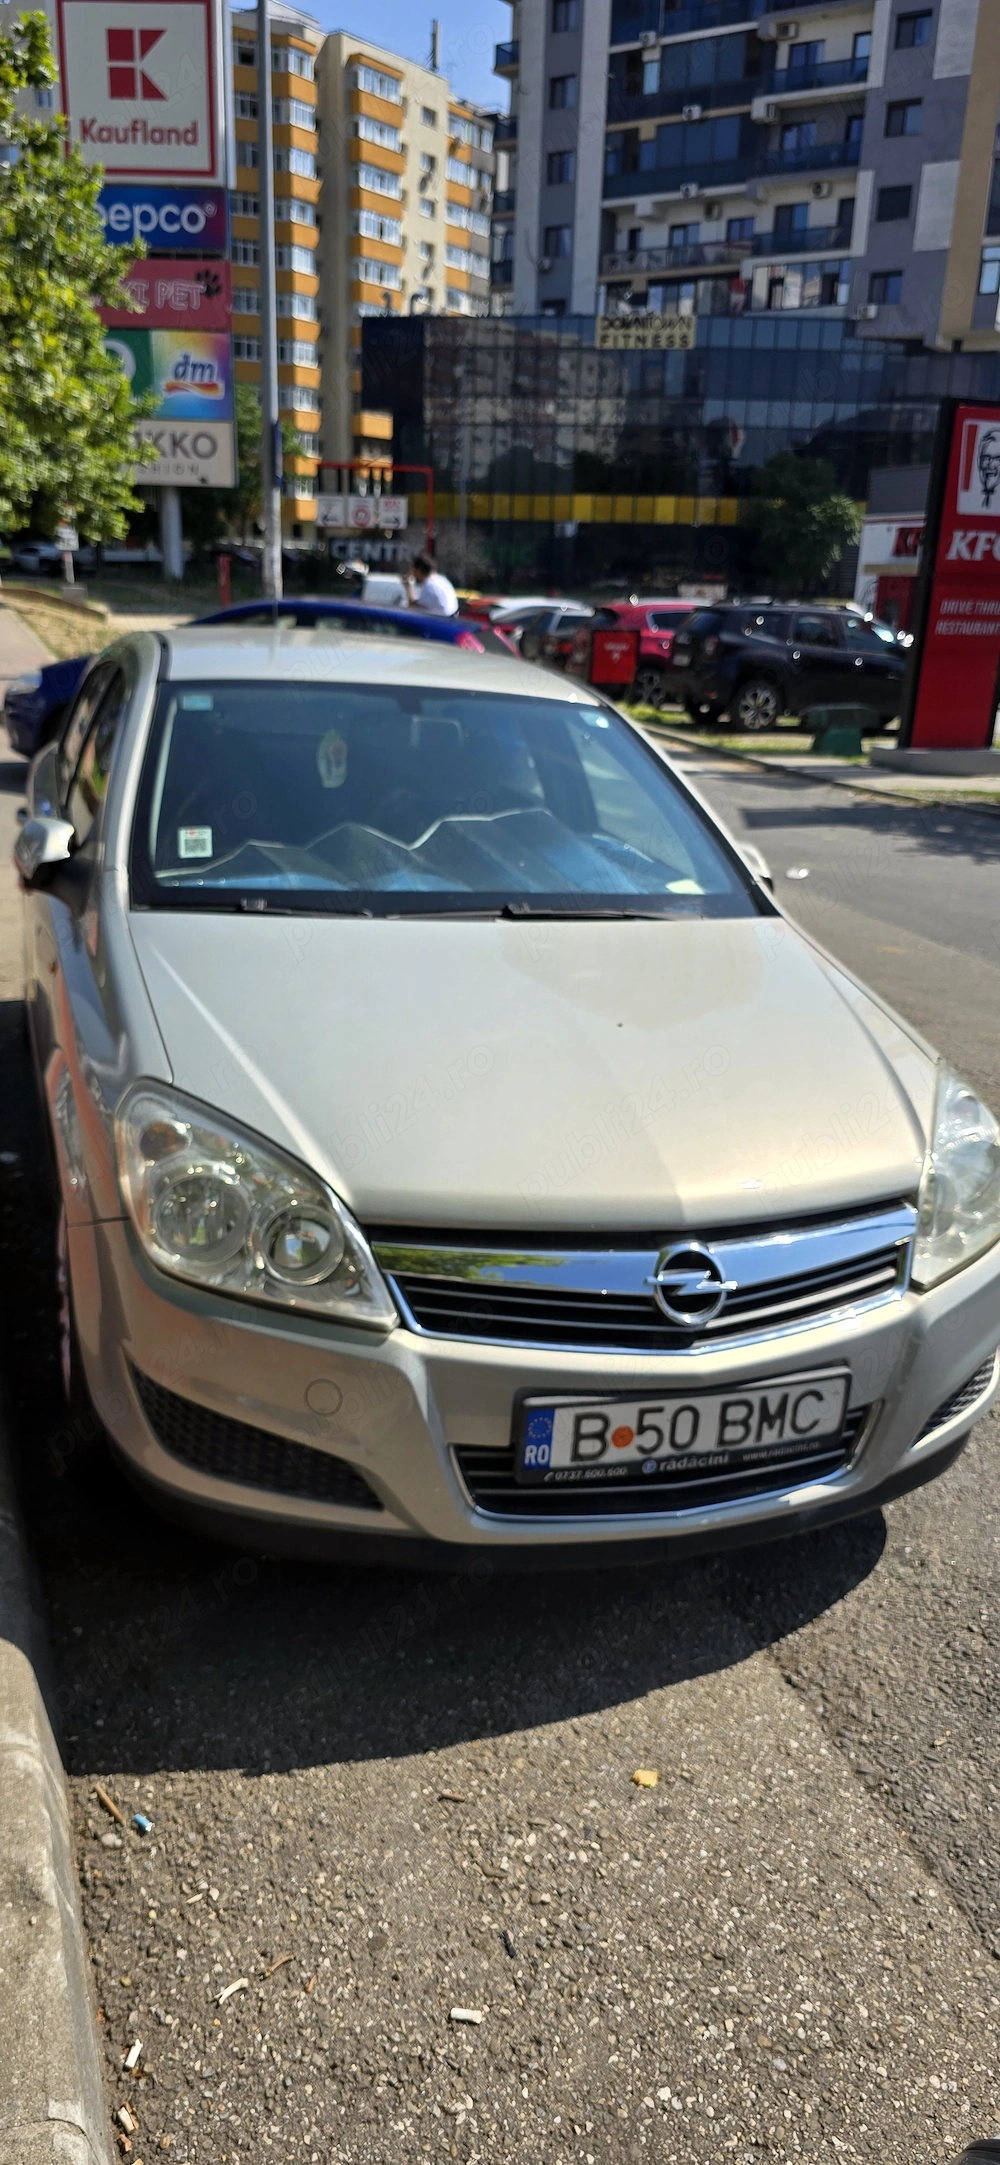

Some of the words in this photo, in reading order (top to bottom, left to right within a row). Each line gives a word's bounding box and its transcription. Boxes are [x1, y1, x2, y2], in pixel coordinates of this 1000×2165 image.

[79, 118, 199, 146] Kaufland
[154, 279, 207, 311] PET
[600, 333, 690, 349] FITNESS
[173, 353, 216, 382] dm
[134, 430, 219, 460] KKO
[940, 599, 974, 615] DRIVE
[571, 1412, 611, 1462] B
[636, 1405, 700, 1454] 50
[717, 1390, 824, 1448] BMC
[524, 1444, 550, 1464] RO
